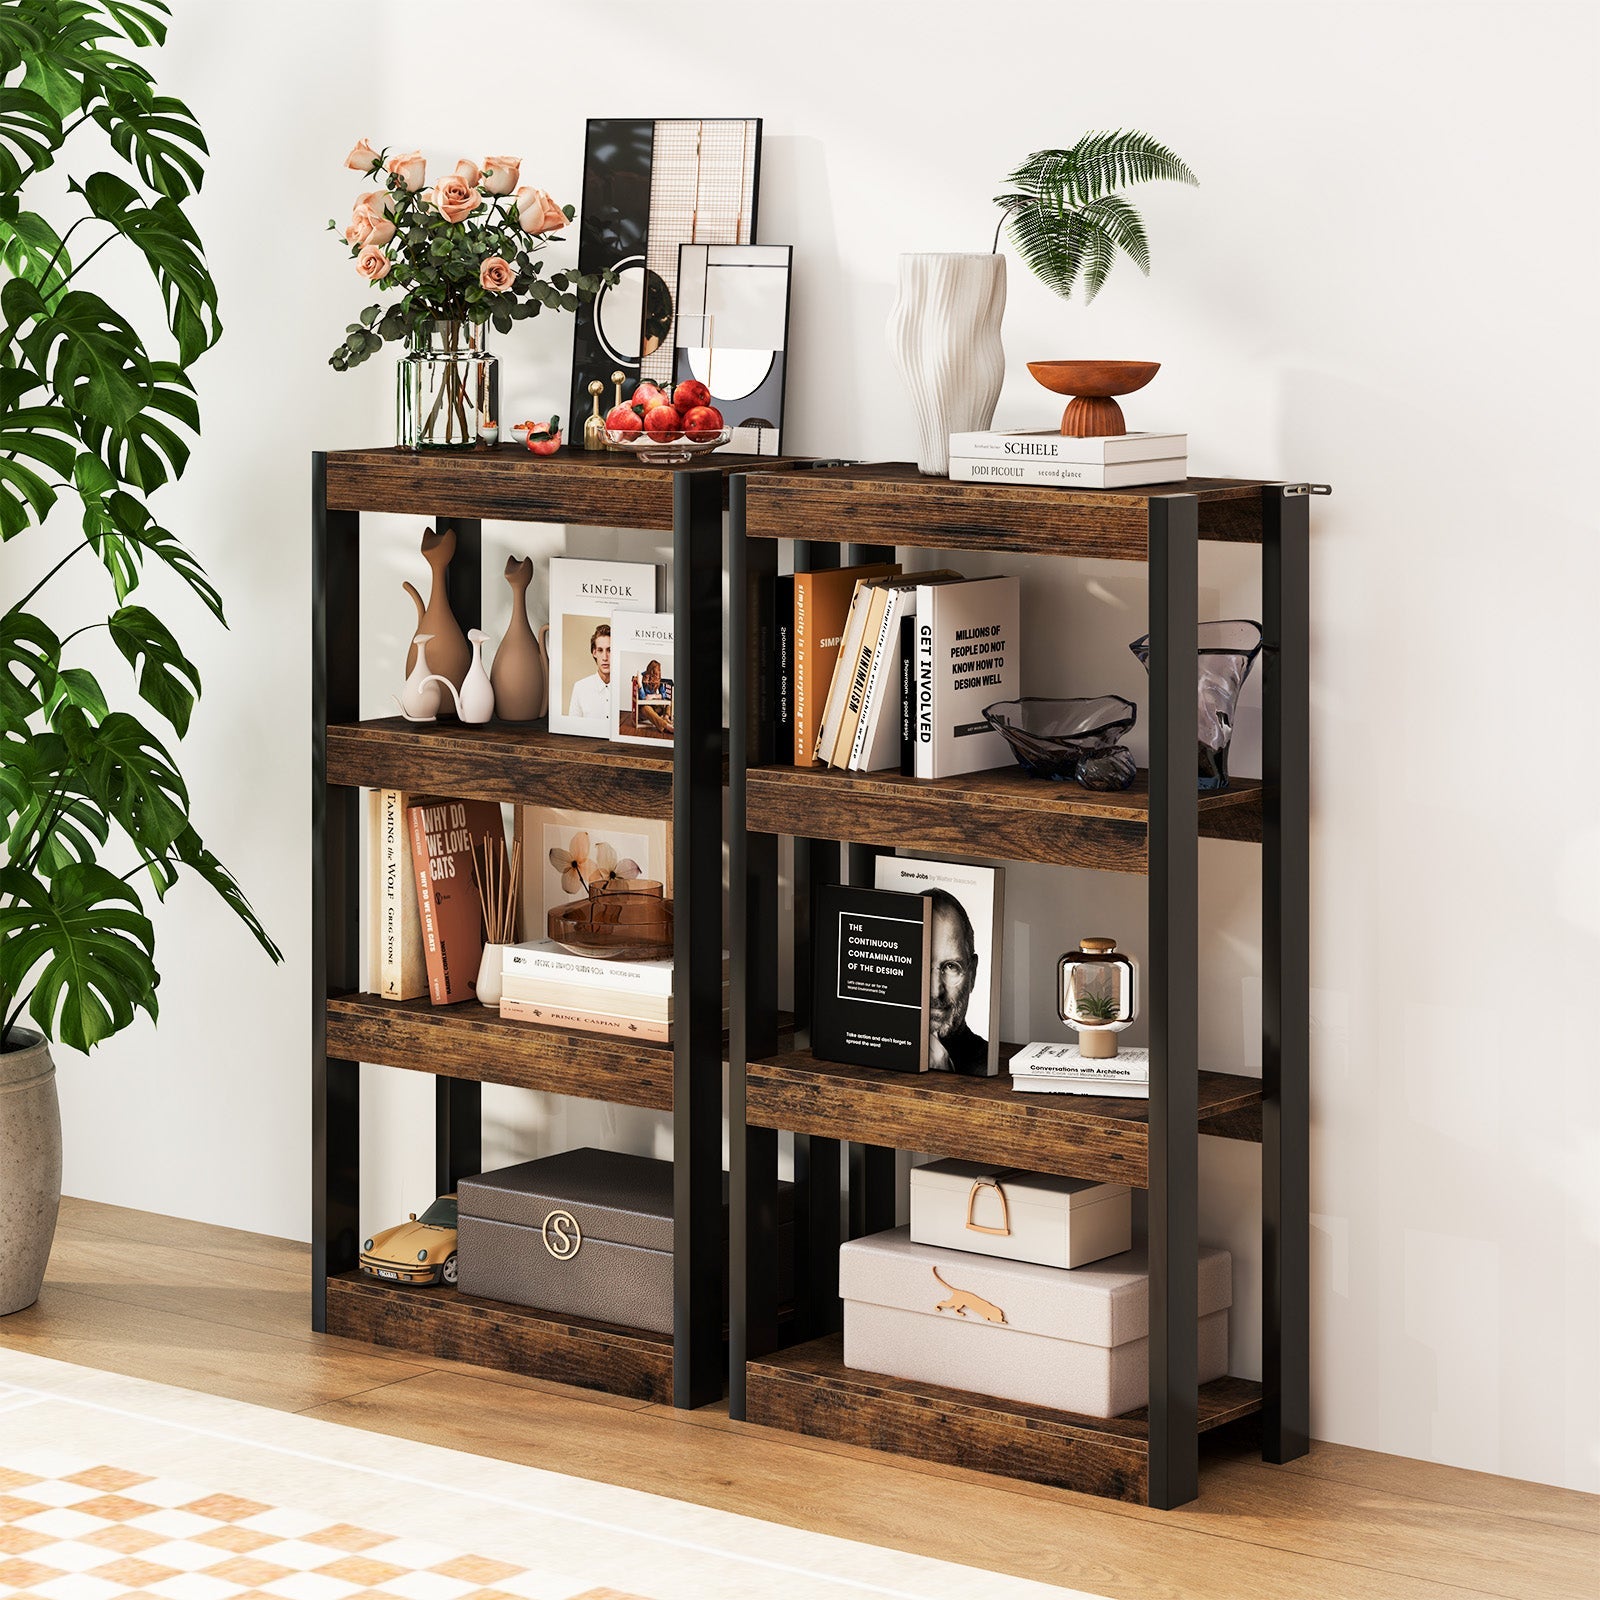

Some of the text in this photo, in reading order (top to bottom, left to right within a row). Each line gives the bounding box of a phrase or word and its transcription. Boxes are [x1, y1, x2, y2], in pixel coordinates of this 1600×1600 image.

[1004, 442, 1059, 457] SCHIELE
[971, 466, 1082, 479] JODI PICOULT second glance
[582, 583, 632, 597] KINFOLK
[797, 584, 805, 636] simplicity
[878, 600, 893, 648] simplicity
[635, 629, 674, 640] KINFOLK
[956, 625, 1001, 641] MILLIONS OF
[799, 638, 804, 648] is
[820, 637, 842, 648] SIMP
[951, 641, 1006, 658] PEOPLE DO NOT
[799, 650, 804, 661] in
[952, 657, 1004, 674] KNOW HOW TO
[849, 645, 873, 714] MINIMALISM
[921, 625, 932, 743] GET INVOLVED
[954, 673, 1002, 691] DESIGN WELL
[797, 664, 805, 719] everything
[799, 720, 804, 735] we
[387, 792, 396, 843] TAMING
[421, 803, 466, 833] WHY DO
[425, 829, 470, 857] WE LOVE
[429, 855, 456, 881] CATS
[900, 870, 915, 878] Steve
[387, 863, 396, 900] WOLF
[420, 870, 436, 953] WHY DO WE LOVE CATS
[849, 923, 863, 932] THE
[848, 936, 898, 950] CONTINUOUS
[848, 949, 912, 965] CONTAMINATION
[847, 962, 904, 977] OF THE DESIGN
[551, 1013, 620, 1028] PRINCE CASPIAN
[1030, 1064, 1079, 1073] Conversations
[1096, 1068, 1130, 1076] Architects
[552, 1216, 571, 1253] S
